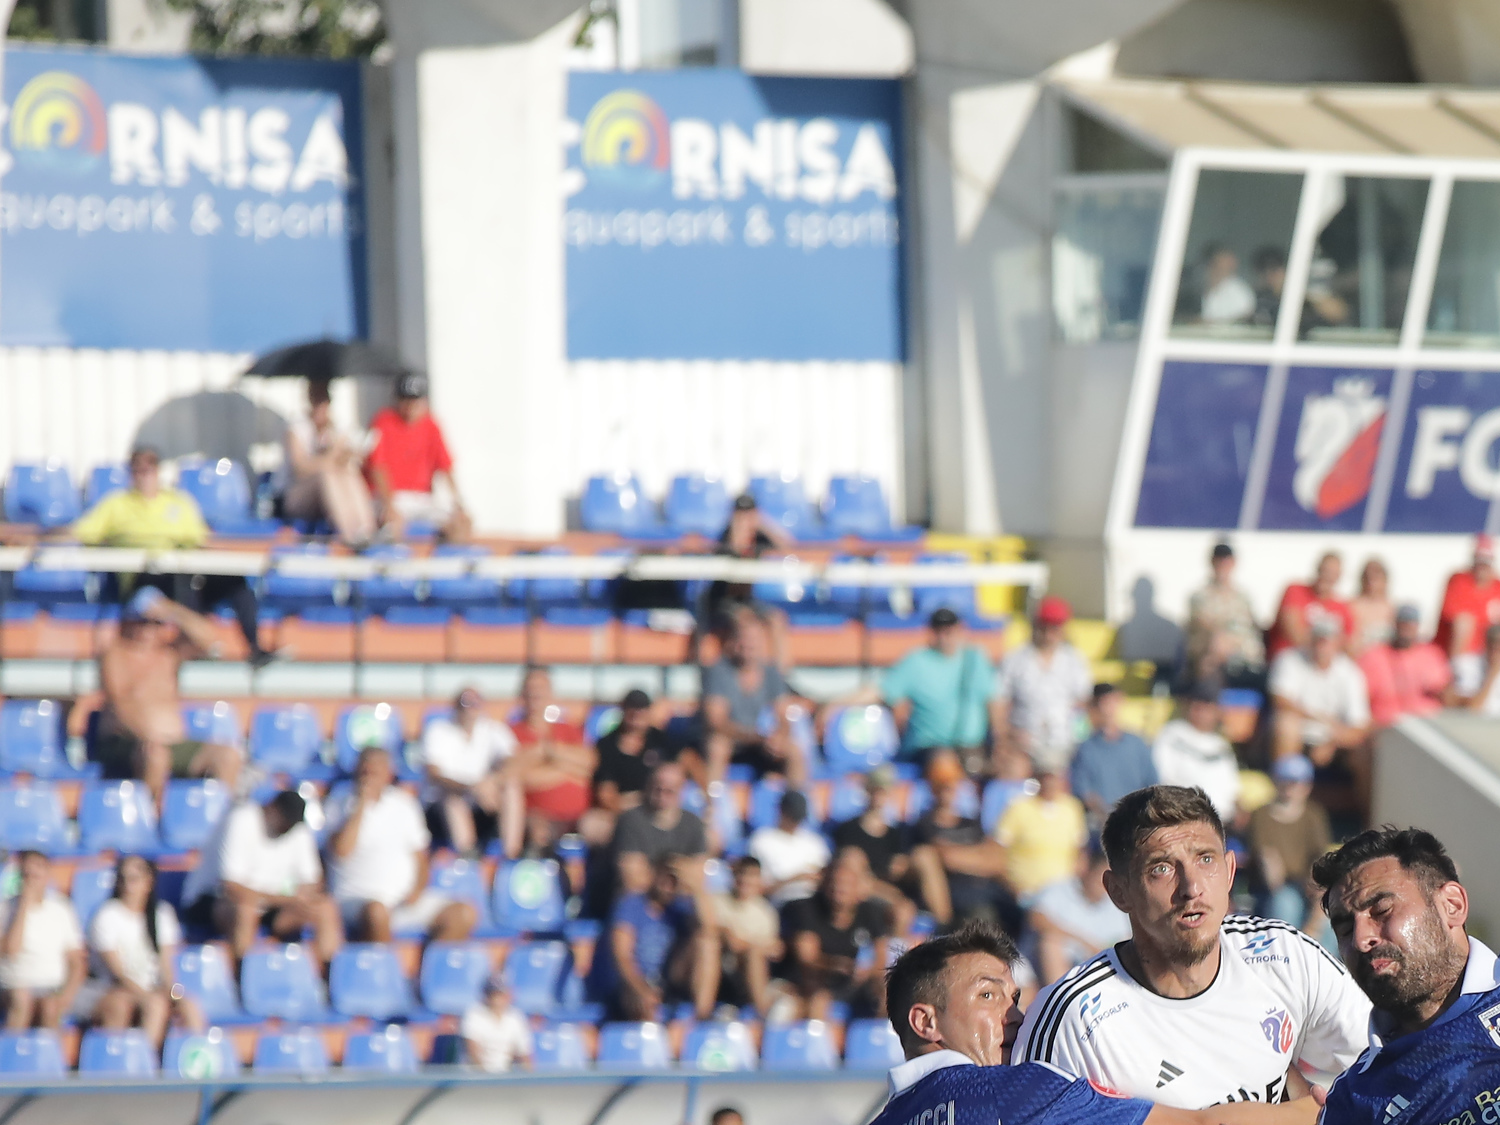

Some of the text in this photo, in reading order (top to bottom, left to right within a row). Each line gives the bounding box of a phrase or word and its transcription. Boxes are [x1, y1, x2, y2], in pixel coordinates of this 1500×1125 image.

[0, 191, 177, 238] quapark
[190, 191, 223, 237] &
[743, 203, 776, 248] &
